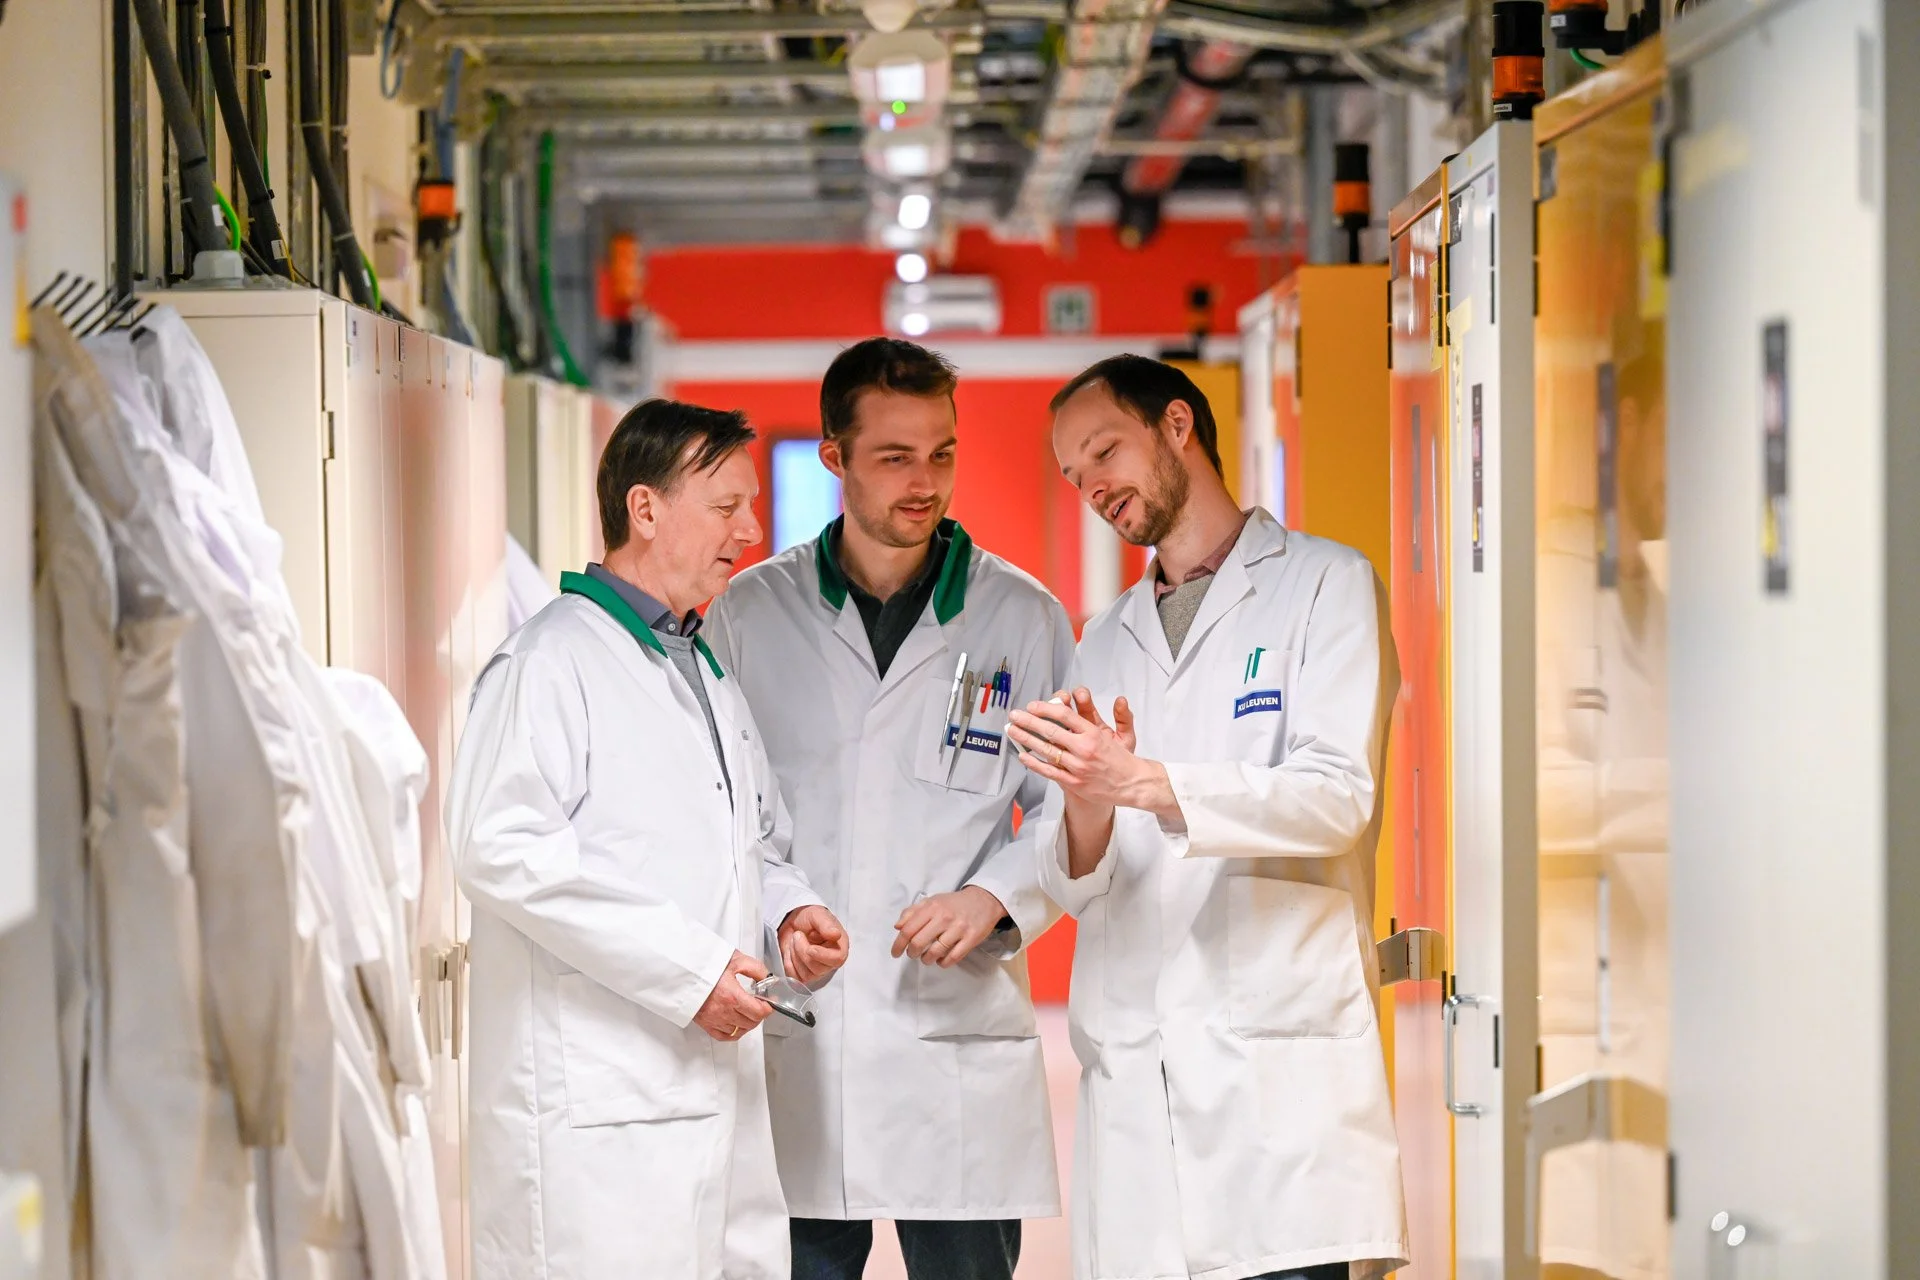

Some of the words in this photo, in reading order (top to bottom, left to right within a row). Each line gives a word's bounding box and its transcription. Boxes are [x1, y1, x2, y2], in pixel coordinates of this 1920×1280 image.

[1238, 703, 1246, 712] KU
[1246, 697, 1278, 708] LEUVEN
[966, 736, 999, 749] LEUVEN
